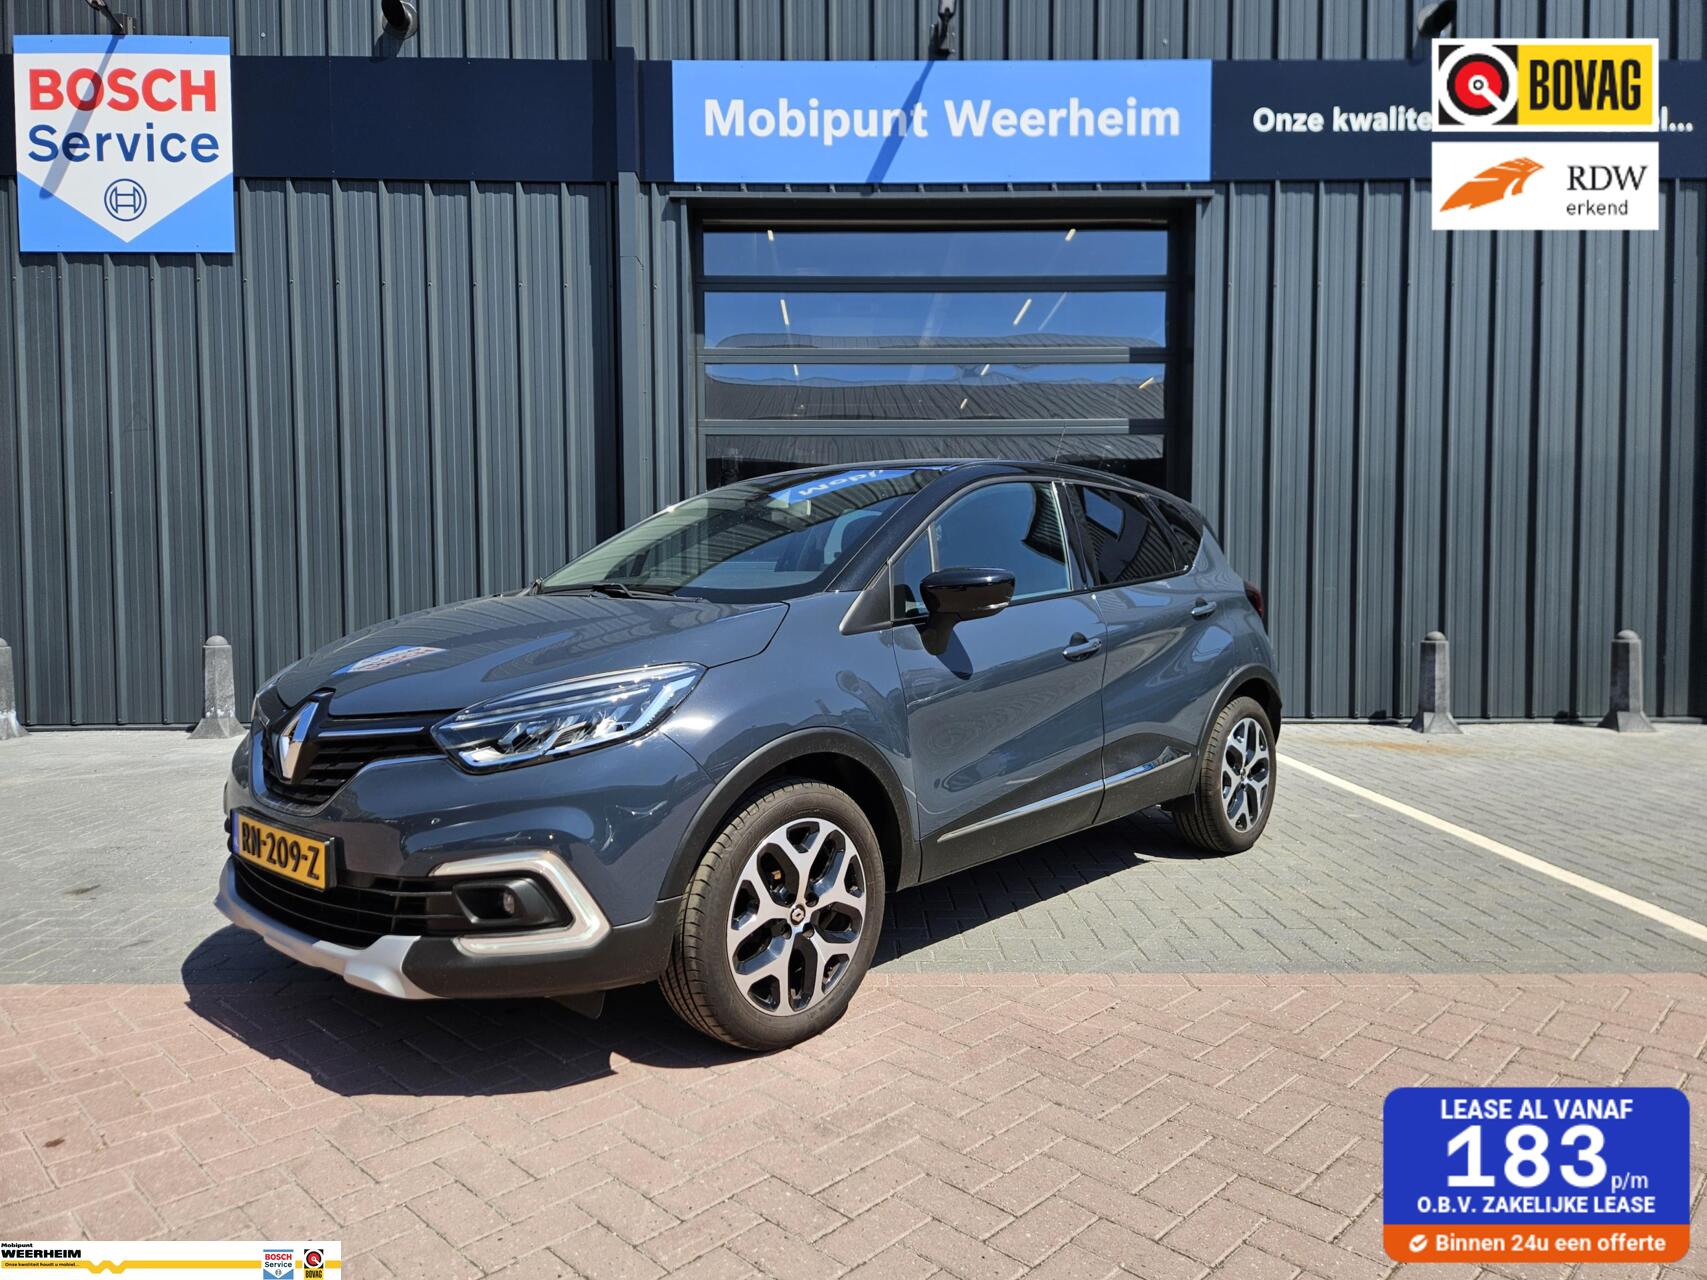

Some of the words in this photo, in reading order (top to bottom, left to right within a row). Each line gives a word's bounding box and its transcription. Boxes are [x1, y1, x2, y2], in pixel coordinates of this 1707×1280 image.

[28, 67, 217, 113] BOSCH
[27, 122, 220, 163] Service
[703, 97, 929, 147] Mobipunt
[943, 96, 1181, 138] Weerheim
[1252, 106, 1325, 133] Onze
[241, 821, 320, 881] RN-209-Z
